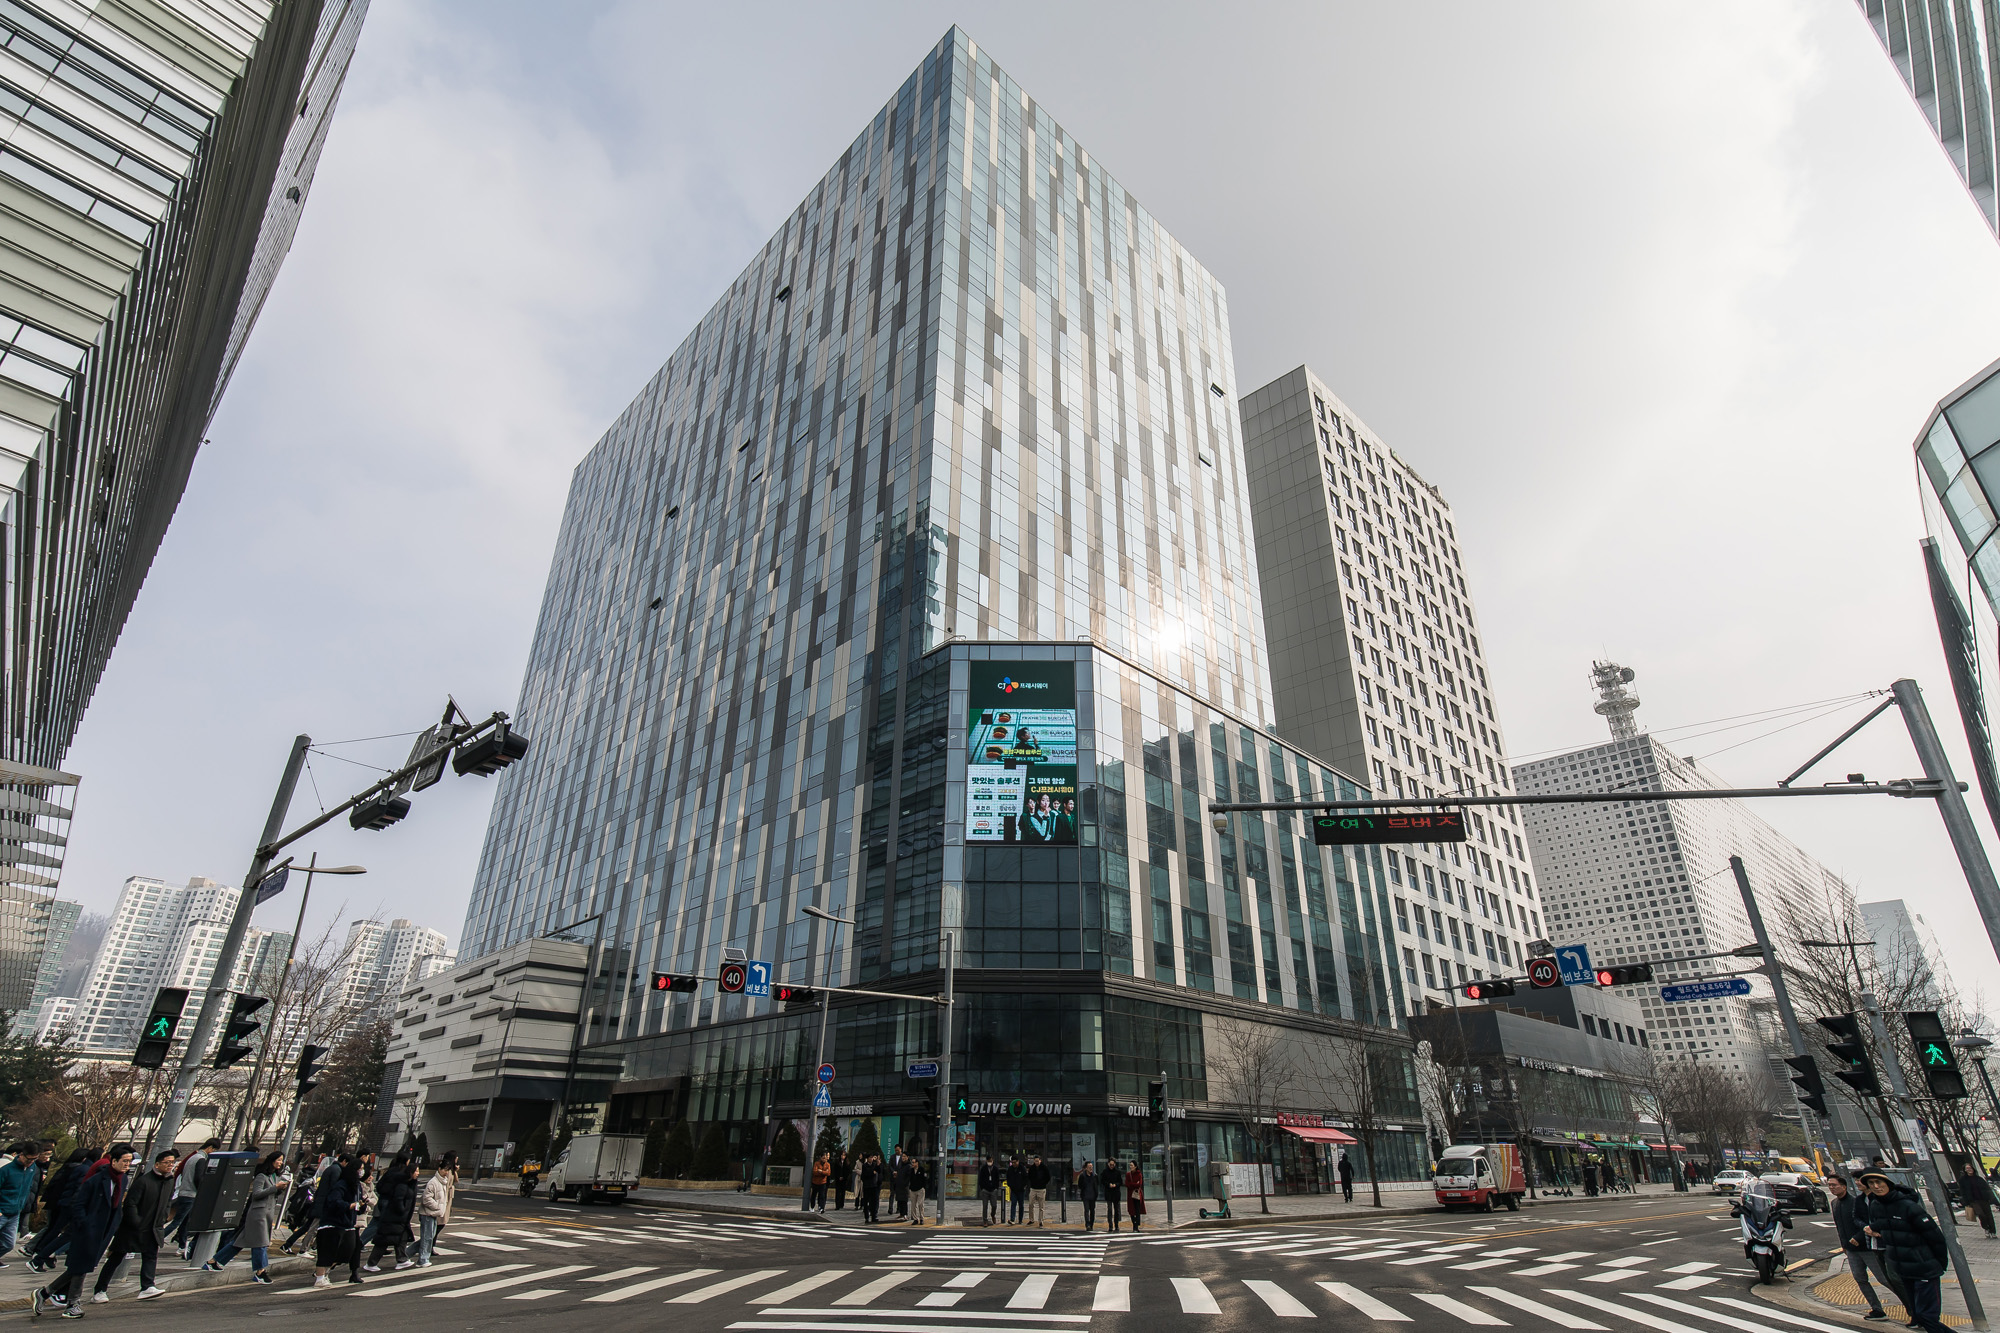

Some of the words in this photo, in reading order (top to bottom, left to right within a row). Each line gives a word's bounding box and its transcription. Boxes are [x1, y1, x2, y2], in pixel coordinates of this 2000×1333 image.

[997, 682, 1006, 690] CJ
[1020, 682, 1049, 690] 프레시웨이
[972, 777, 995, 785] 맛있는
[997, 777, 1020, 785] 솔루션
[726, 972, 740, 985] 40
[1535, 967, 1552, 980] 40
[1564, 970, 1593, 984] 비보호
[746, 984, 768, 995] 비보호
[1677, 981, 1732, 994] 월드컵북로56길
[855, 1105, 873, 1115] STORE
[971, 1103, 1008, 1115] OLIVE
[1028, 1103, 1072, 1115] YOUNG
[1128, 1106, 1150, 1117] OLIVE
[506, 1143, 513, 1151] P
